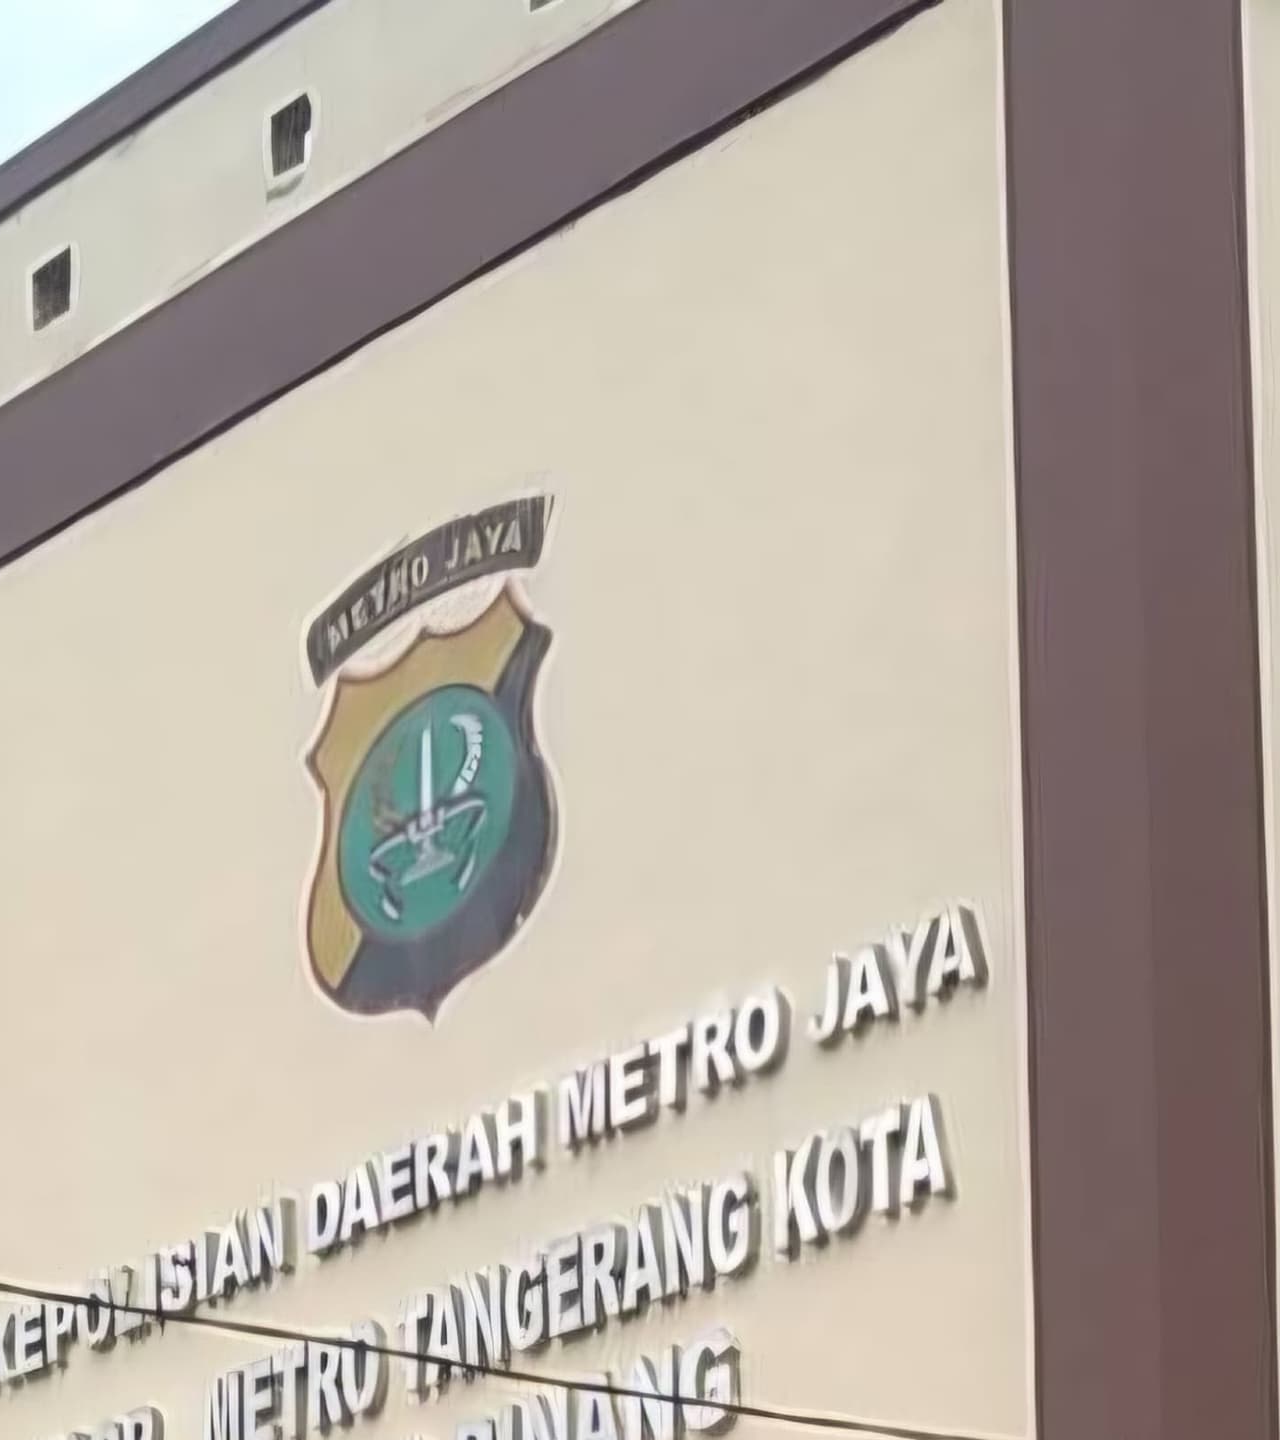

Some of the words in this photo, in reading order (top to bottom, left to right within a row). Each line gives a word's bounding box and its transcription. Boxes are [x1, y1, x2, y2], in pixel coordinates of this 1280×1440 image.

[325, 552, 431, 653] METRO
[445, 518, 523, 571] JAYA
[307, 1087, 548, 1254] DAERAH
[558, 984, 790, 1149] METRO
[809, 904, 987, 1047] JAYA
[400, 1172, 760, 1400] TANGERANG
[774, 1094, 956, 1260] KOTA
